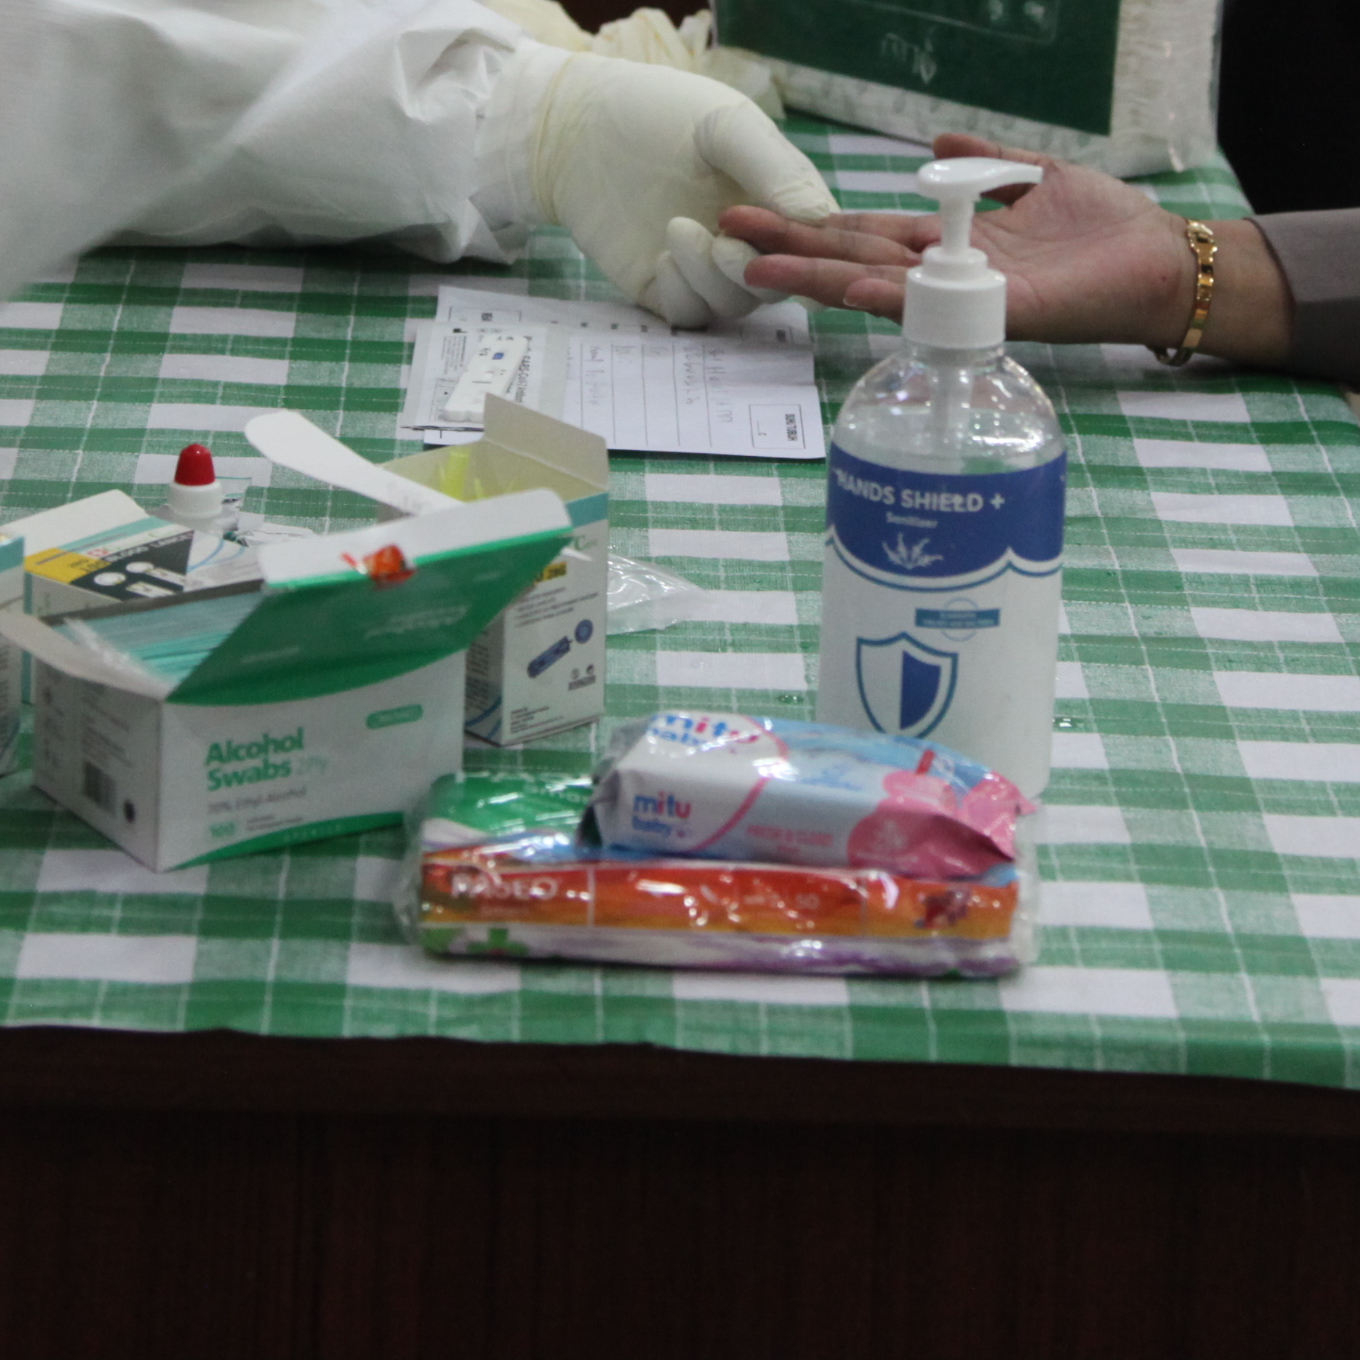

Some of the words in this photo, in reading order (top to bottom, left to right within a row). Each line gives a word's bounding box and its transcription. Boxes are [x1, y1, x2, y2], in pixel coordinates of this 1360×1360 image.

[900, 489, 984, 513] SHIELD
[205, 726, 305, 766] Alcohol
[207, 757, 293, 792] Swabs
[633, 791, 692, 819] mitu
